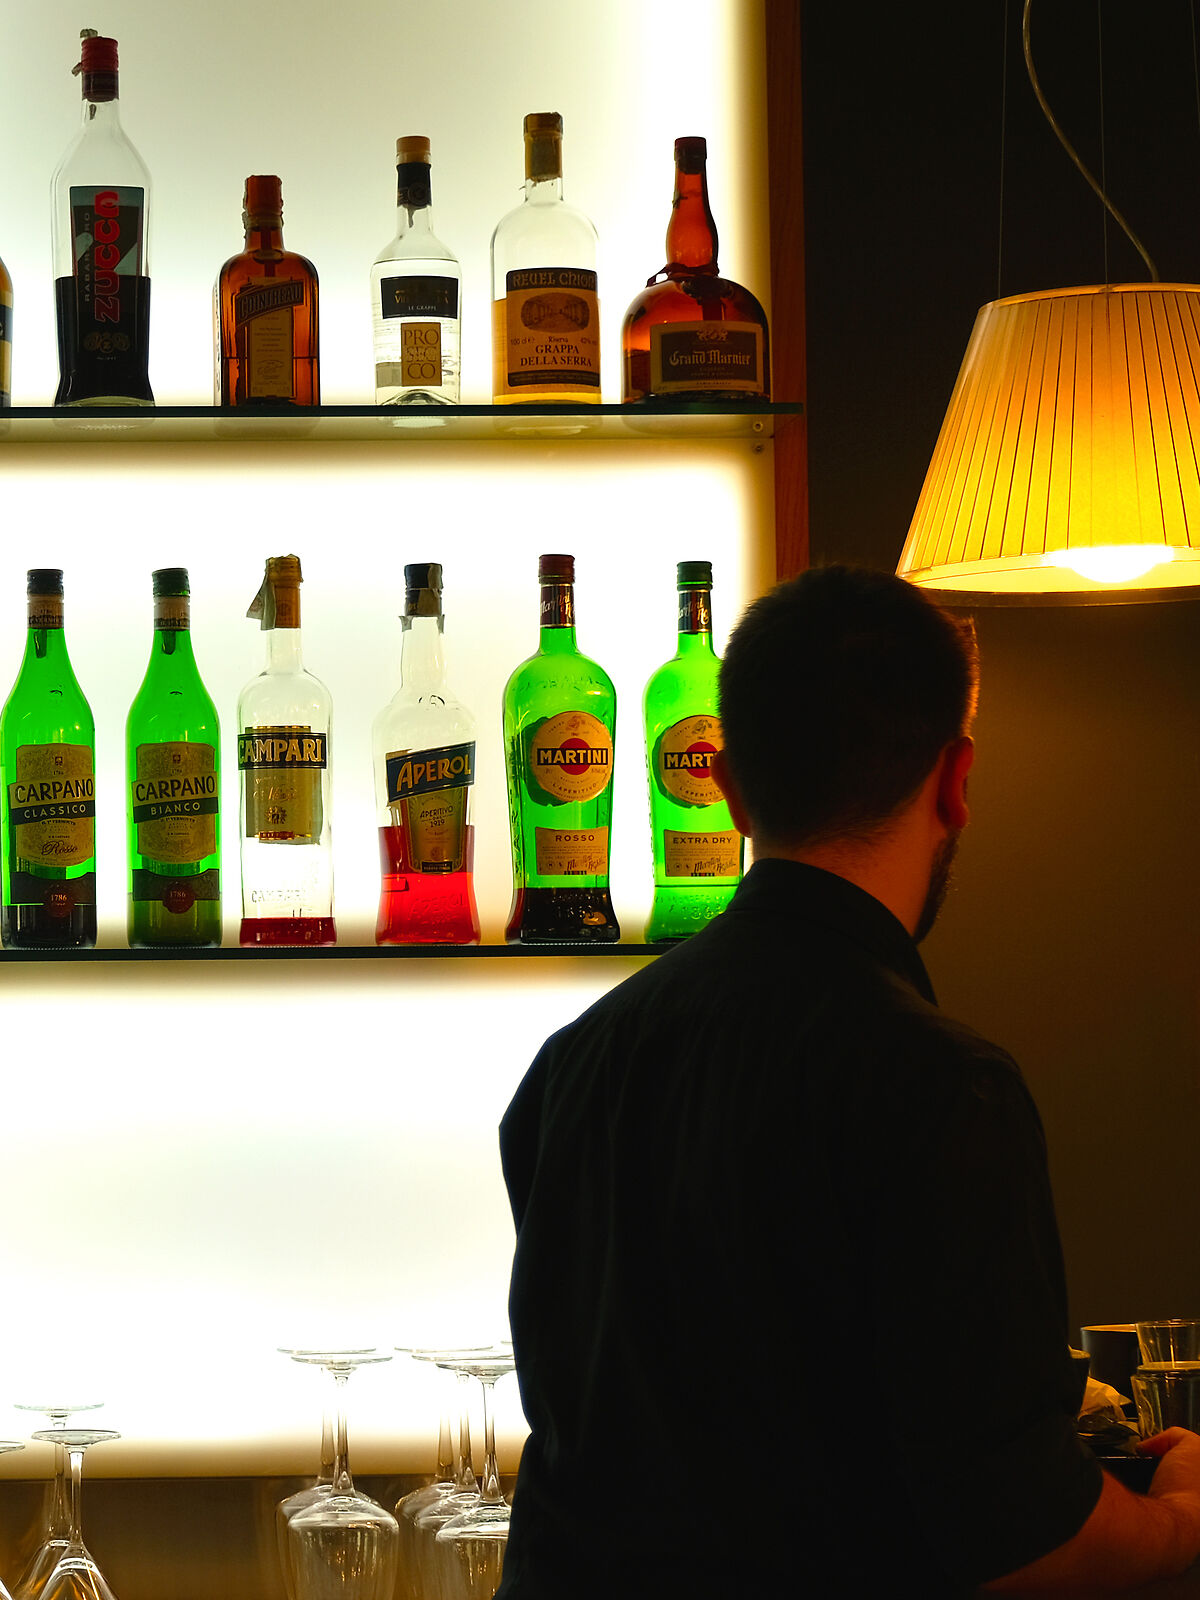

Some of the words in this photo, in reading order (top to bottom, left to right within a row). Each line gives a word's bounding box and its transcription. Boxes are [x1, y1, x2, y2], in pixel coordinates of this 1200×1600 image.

[94, 190, 121, 324] ZUCCA
[403, 328, 440, 346] PRO
[535, 345, 580, 354] GRAPPA
[669, 350, 706, 367] Grand
[707, 349, 751, 366] Marnier
[520, 357, 558, 367] DELLA
[560, 356, 592, 367] SERRA
[407, 362, 436, 380] CO
[239, 738, 323, 763] CAMPARI
[539, 749, 607, 764] MARTINI
[666, 753, 714, 768] MART
[396, 753, 472, 793] APEROL
[14, 778, 94, 804] CARPANO
[135, 775, 215, 802] CARPANO
[23, 803, 86, 819] CLASSICO
[150, 802, 201, 816] BIANCO
[555, 834, 595, 842] ROSSO
[712, 836, 732, 844] DRY
